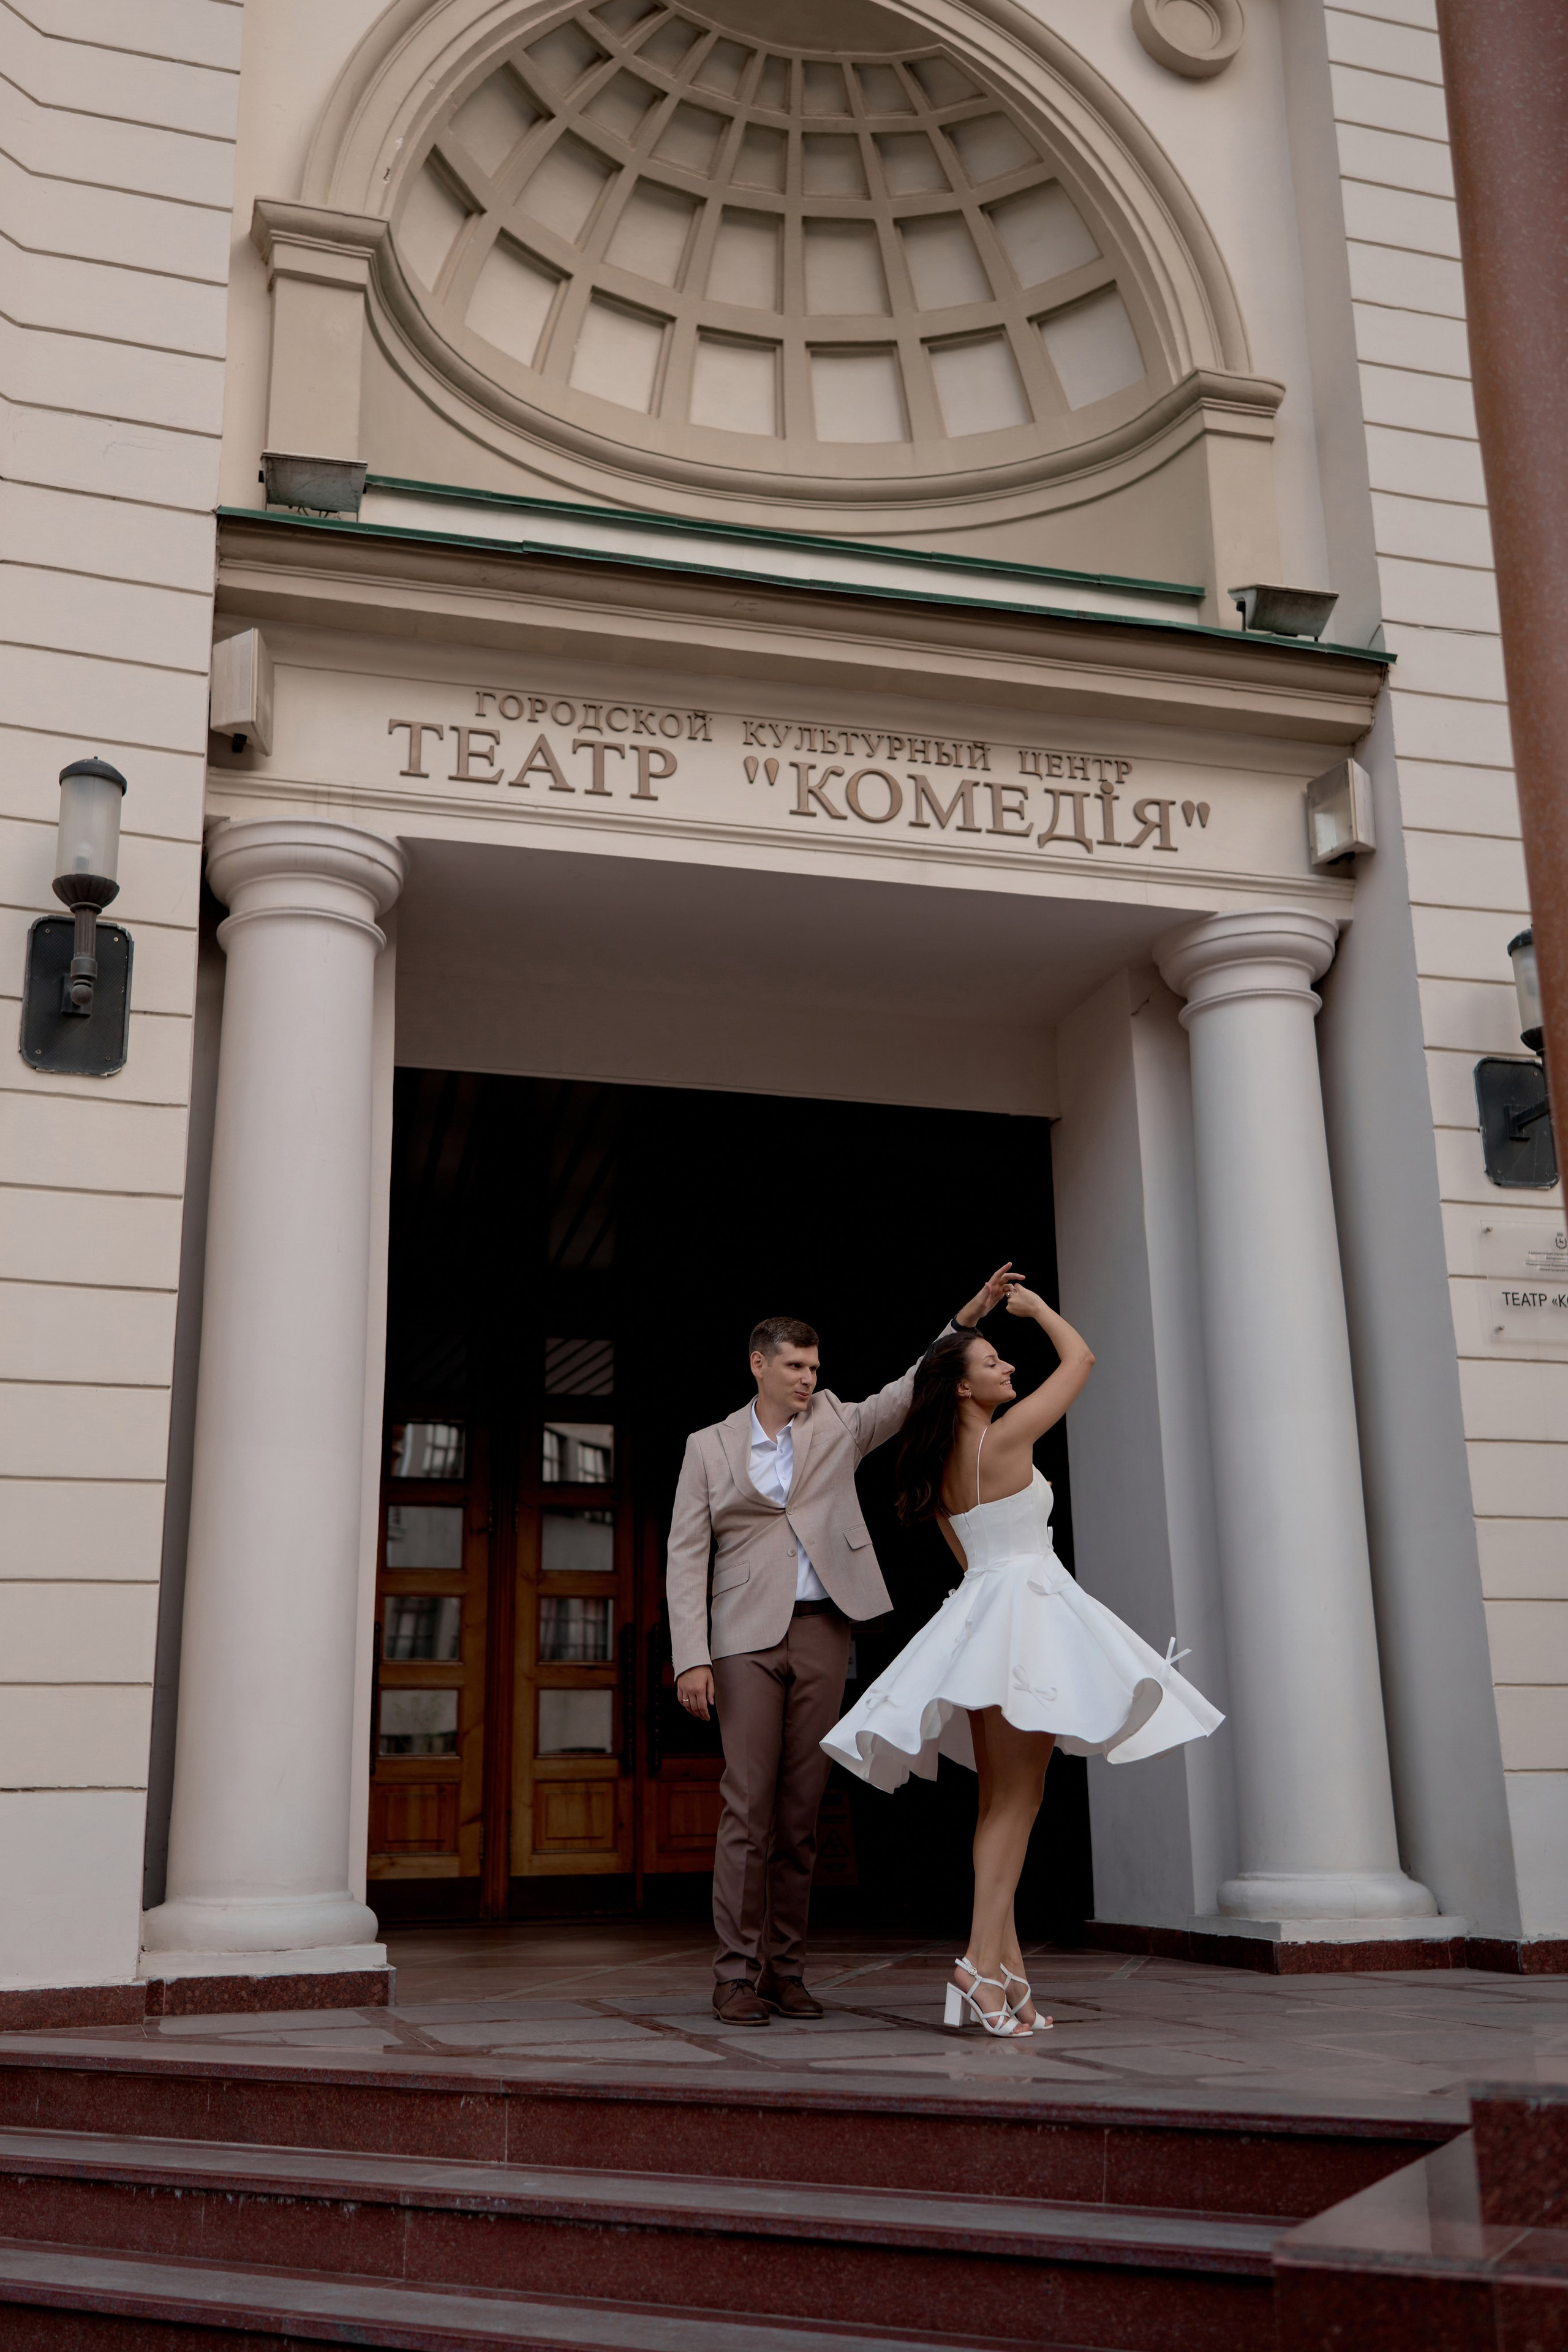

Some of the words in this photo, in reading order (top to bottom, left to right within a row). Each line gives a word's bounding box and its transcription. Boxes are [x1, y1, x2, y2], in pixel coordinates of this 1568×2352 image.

[388, 718, 678, 801] ТЕАТР
[475, 691, 712, 742] ГОРОДСКОЙ
[742, 720, 991, 771] КУЛЬТУРНЫЙ
[1019, 750, 1133, 783] ЦЕНТР
[1502, 1292, 1547, 1306] ТЕАТР
[1551, 1294, 1568, 1308] «К
